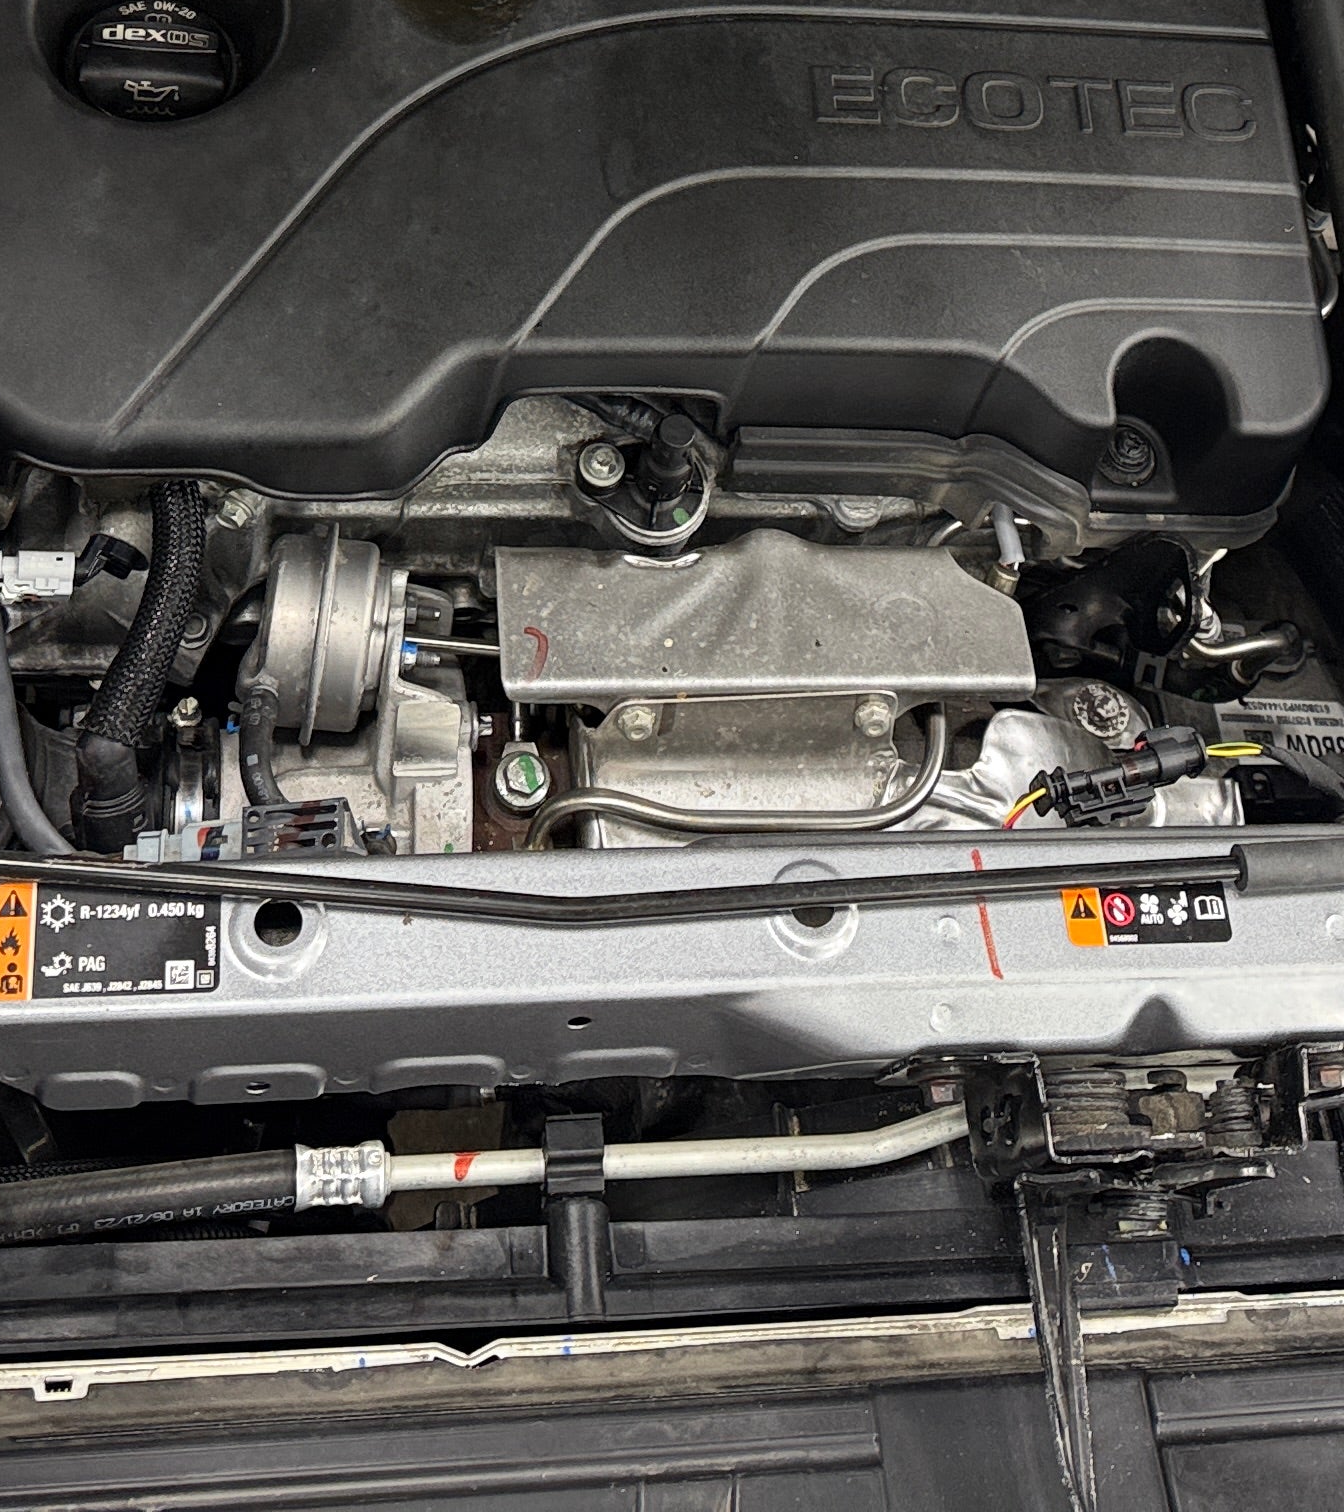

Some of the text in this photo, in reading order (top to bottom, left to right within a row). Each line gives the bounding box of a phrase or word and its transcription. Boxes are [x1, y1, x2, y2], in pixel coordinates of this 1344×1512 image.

[119, 0, 197, 21] SAE 0W-20
[102, 24, 210, 48] dexos
[809, 63, 1258, 142] ECOTEC
[79, 902, 205, 922] R-1234yf 0.450 kg
[1140, 913, 1164, 925] AUTO
[77, 956, 106, 972] PAG
[62, 982, 80, 993] SAE
[182, 1206, 203, 1218] 1A
[212, 1194, 295, 1216] CATEGORY
[93, 1209, 174, 1230] 06/21/23
